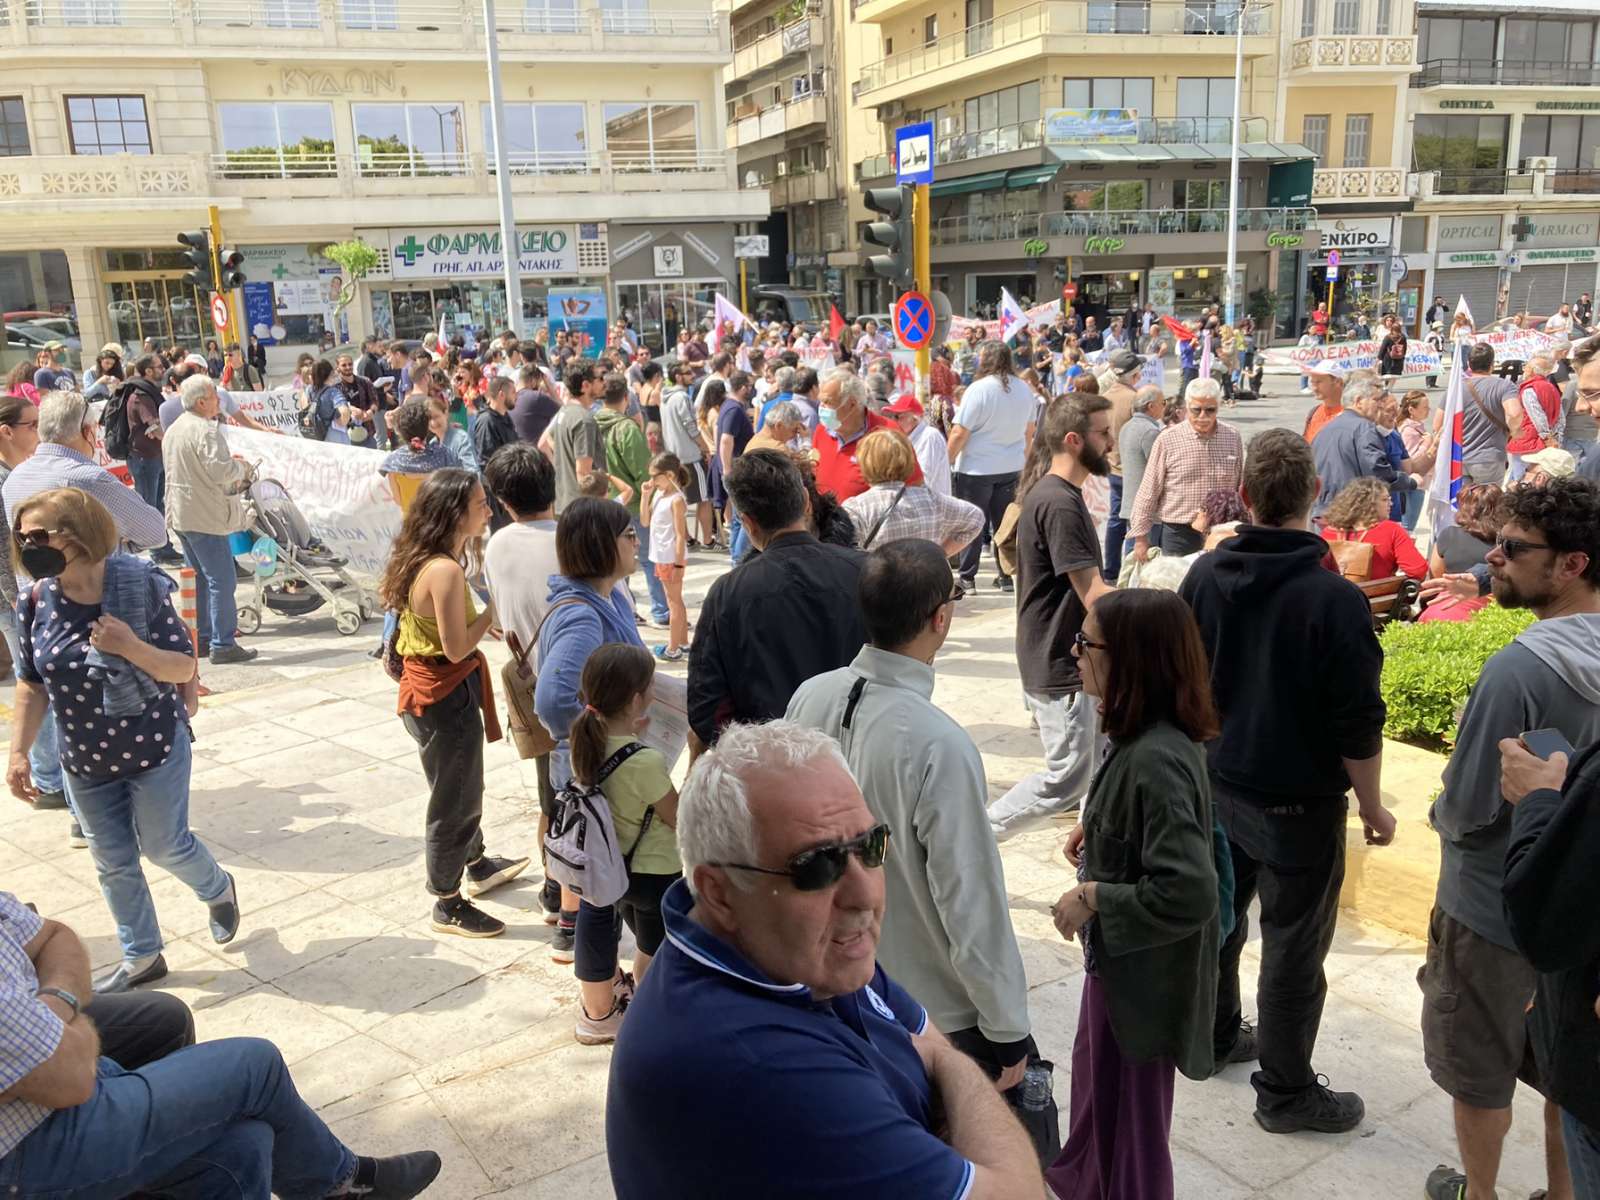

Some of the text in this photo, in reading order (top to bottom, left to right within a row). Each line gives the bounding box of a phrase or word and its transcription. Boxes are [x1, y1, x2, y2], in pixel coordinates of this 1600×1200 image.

[280, 68, 397, 96] ΚΥΔΩΝ
[1440, 225, 1497, 239] OPTICAL
[427, 230, 567, 256] ΦΑΡΜΚΕΙΟ
[486, 258, 564, 272] ΑΡΝΤΑΚΗΣ
